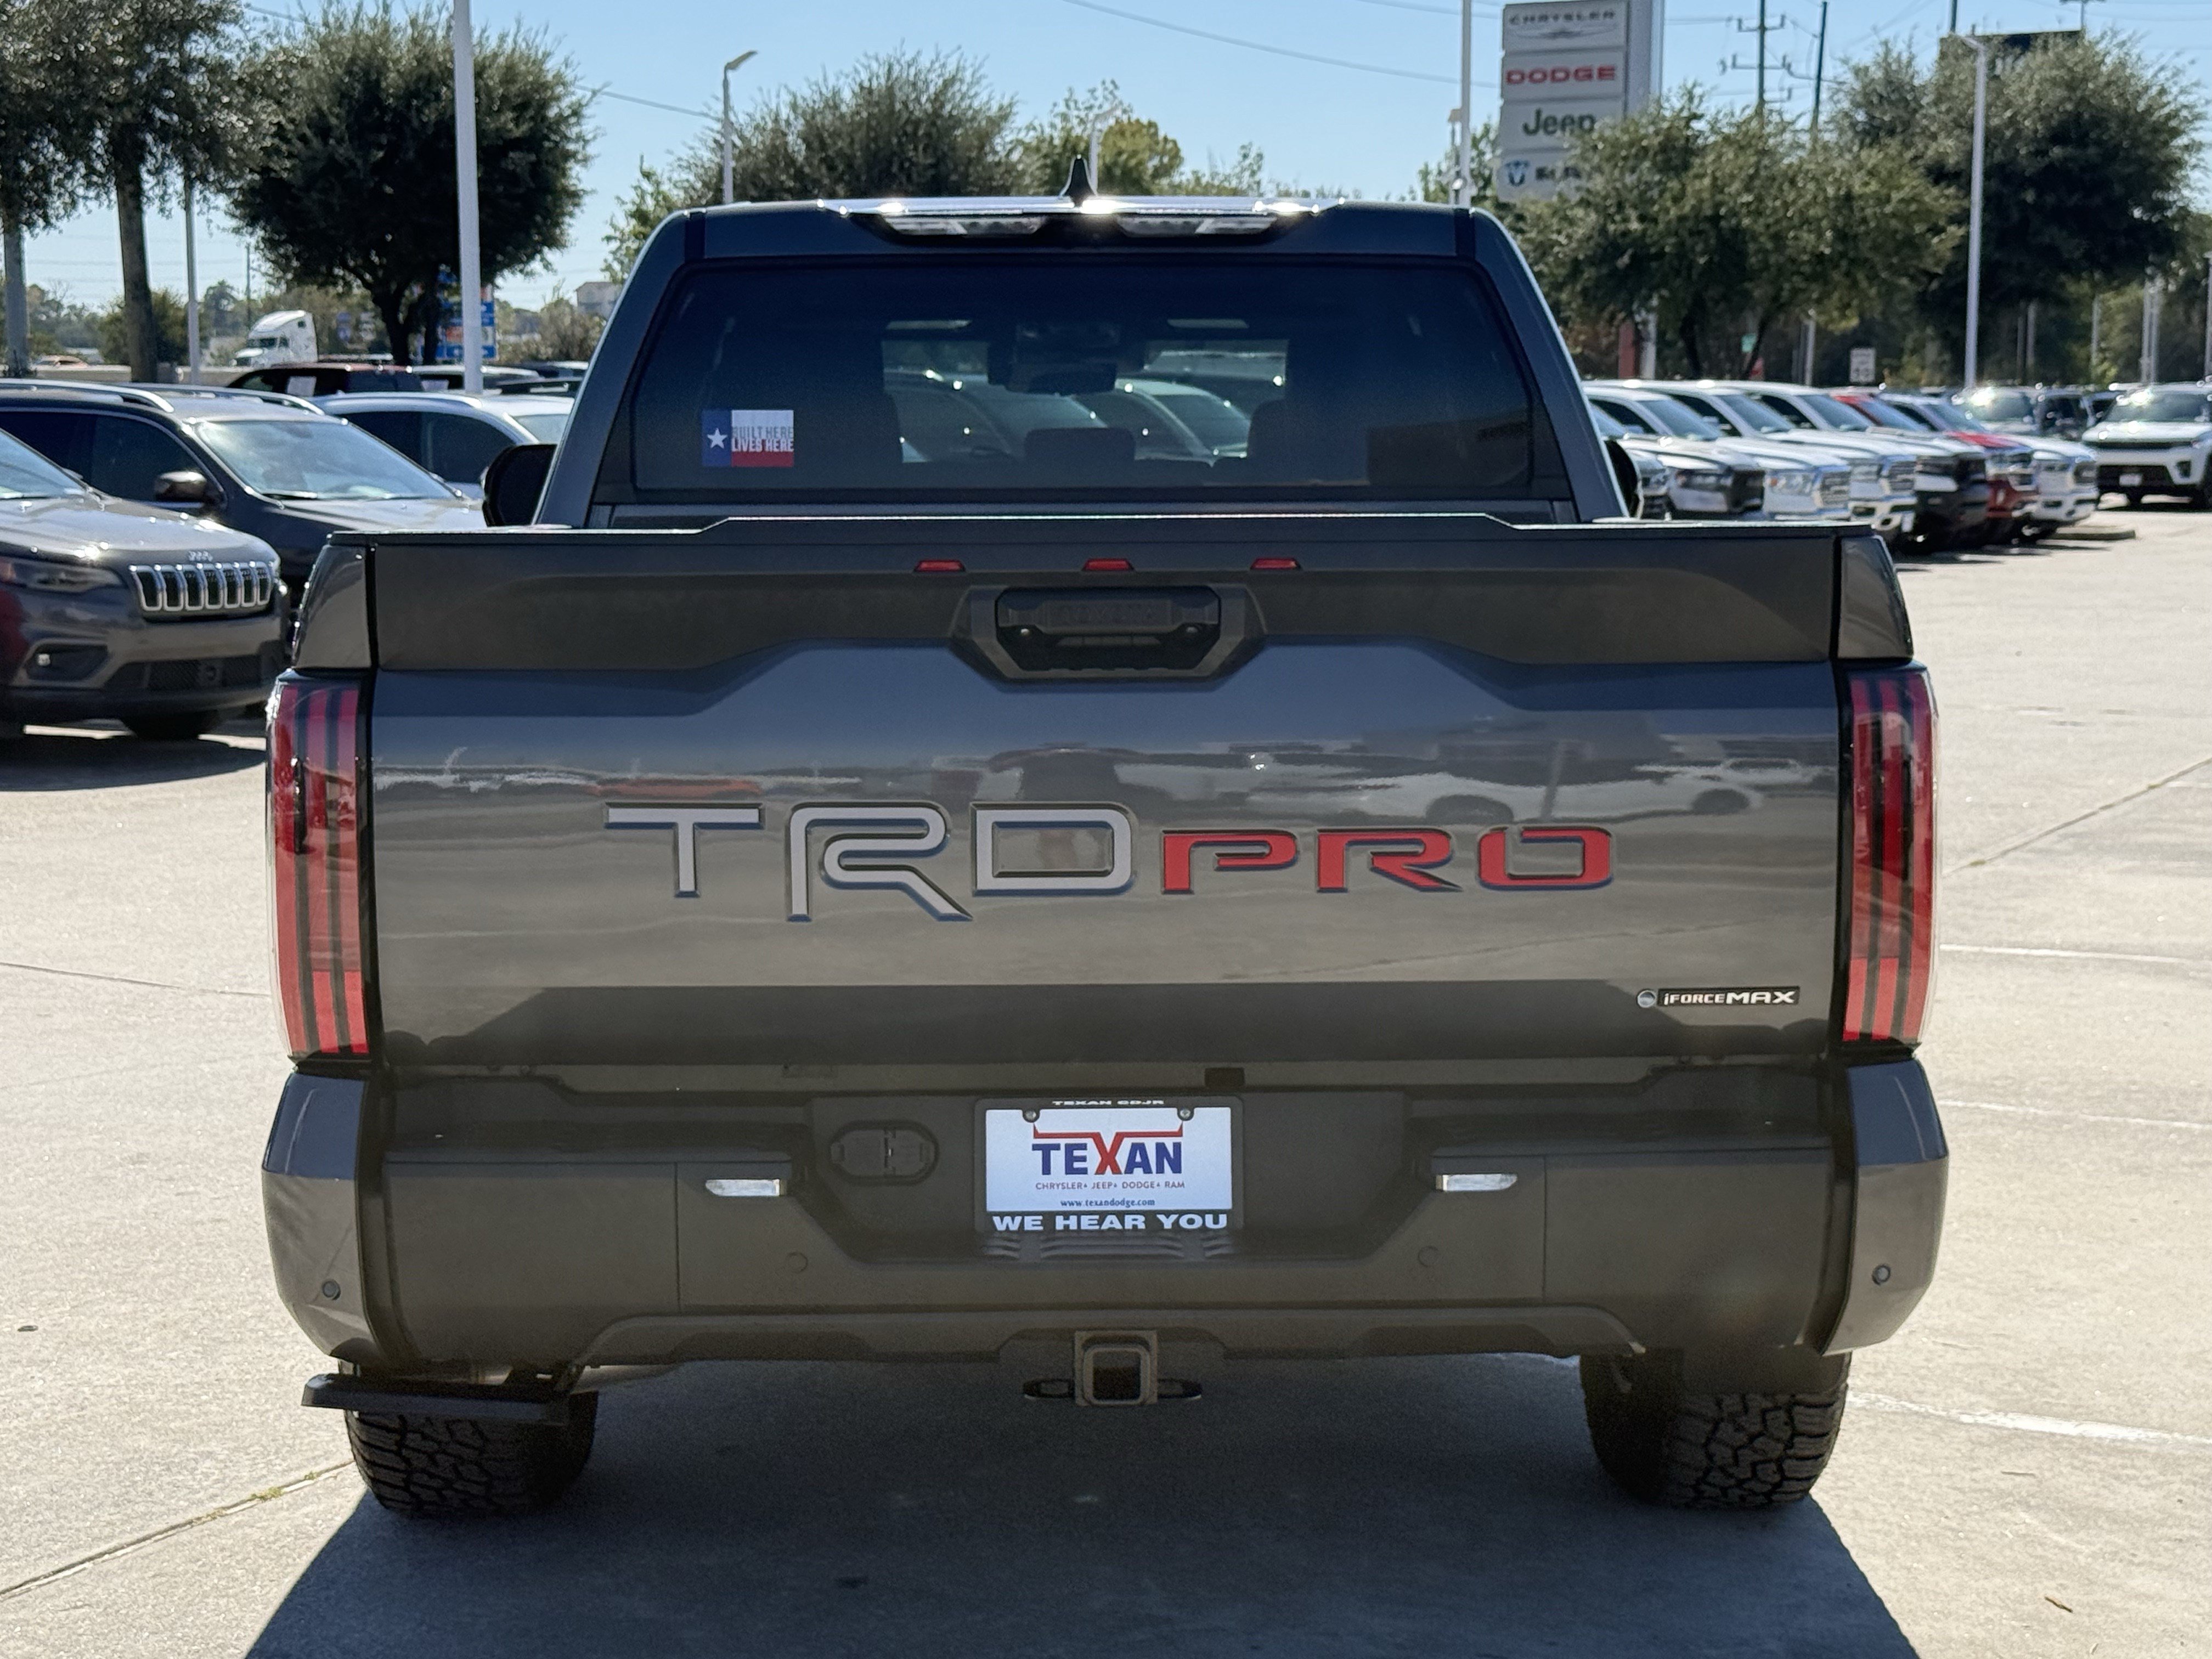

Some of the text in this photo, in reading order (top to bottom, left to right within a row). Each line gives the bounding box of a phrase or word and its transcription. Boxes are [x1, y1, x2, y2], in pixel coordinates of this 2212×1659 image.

[1506, 64, 1616, 84] DODGE
[1522, 109, 1596, 136] Jeep
[766, 426, 794, 439] HERE
[731, 438, 794, 452] LIVES HERE
[605, 802, 1612, 922] TRD PRO
[1031, 1131, 1183, 1176] TEXAN
[1035, 1180, 1185, 1190] CHRYSLER JEEP DODGE RAM
[1060, 1197, 1155, 1208] www.texandodge.com
[992, 1213, 1228, 1231] WE HEAR YOU
